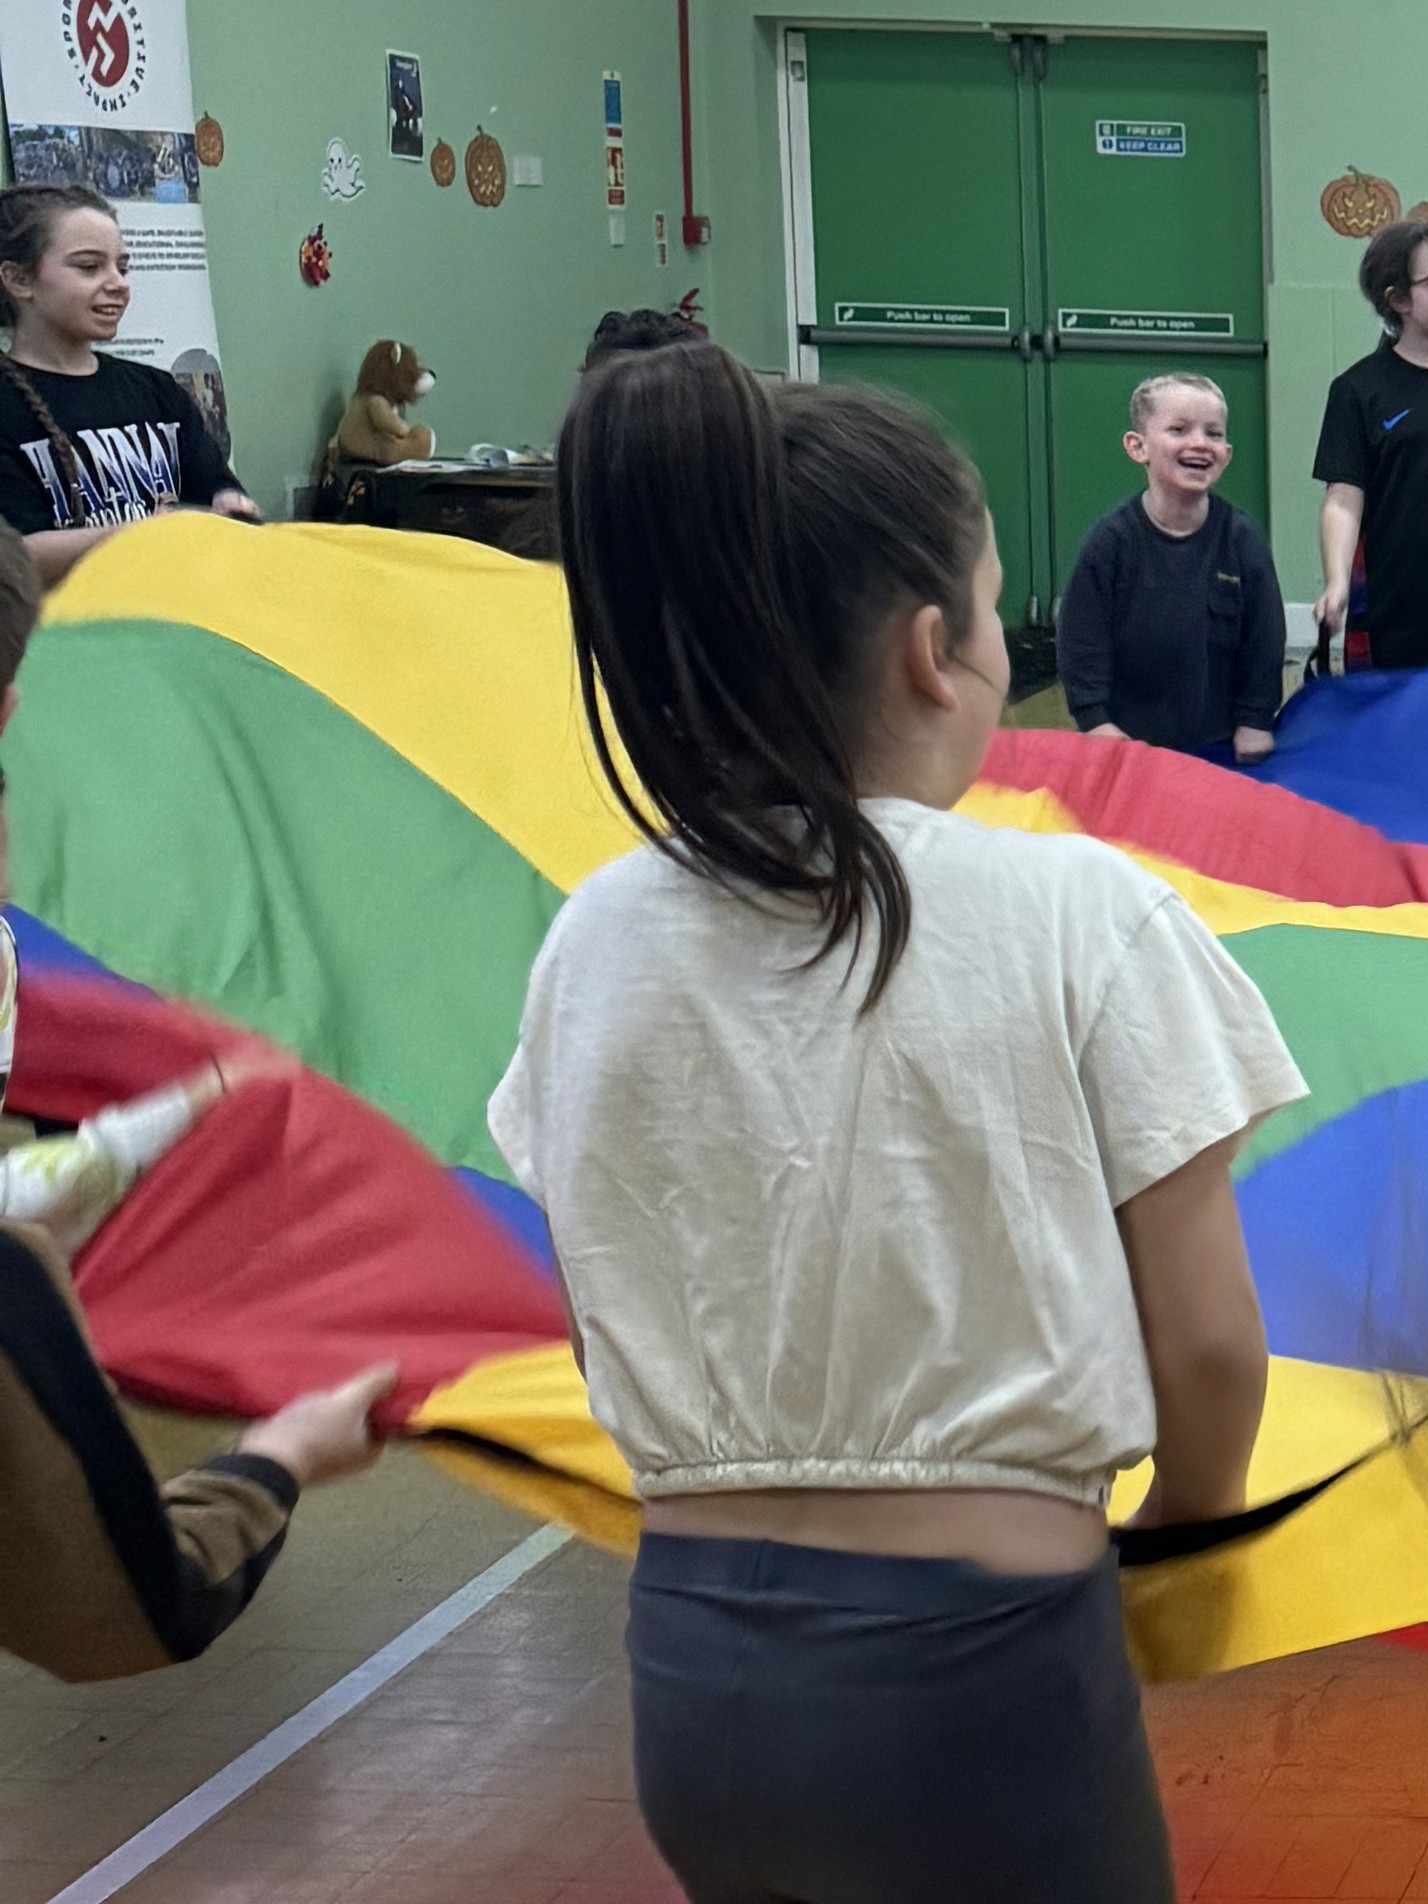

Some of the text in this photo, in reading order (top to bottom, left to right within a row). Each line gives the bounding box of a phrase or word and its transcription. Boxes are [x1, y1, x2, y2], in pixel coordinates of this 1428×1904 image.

[1147, 141, 1181, 152] CLEAR
[886, 310, 971, 325] Push bar to open
[1110, 317, 1195, 332] Push bar to open
